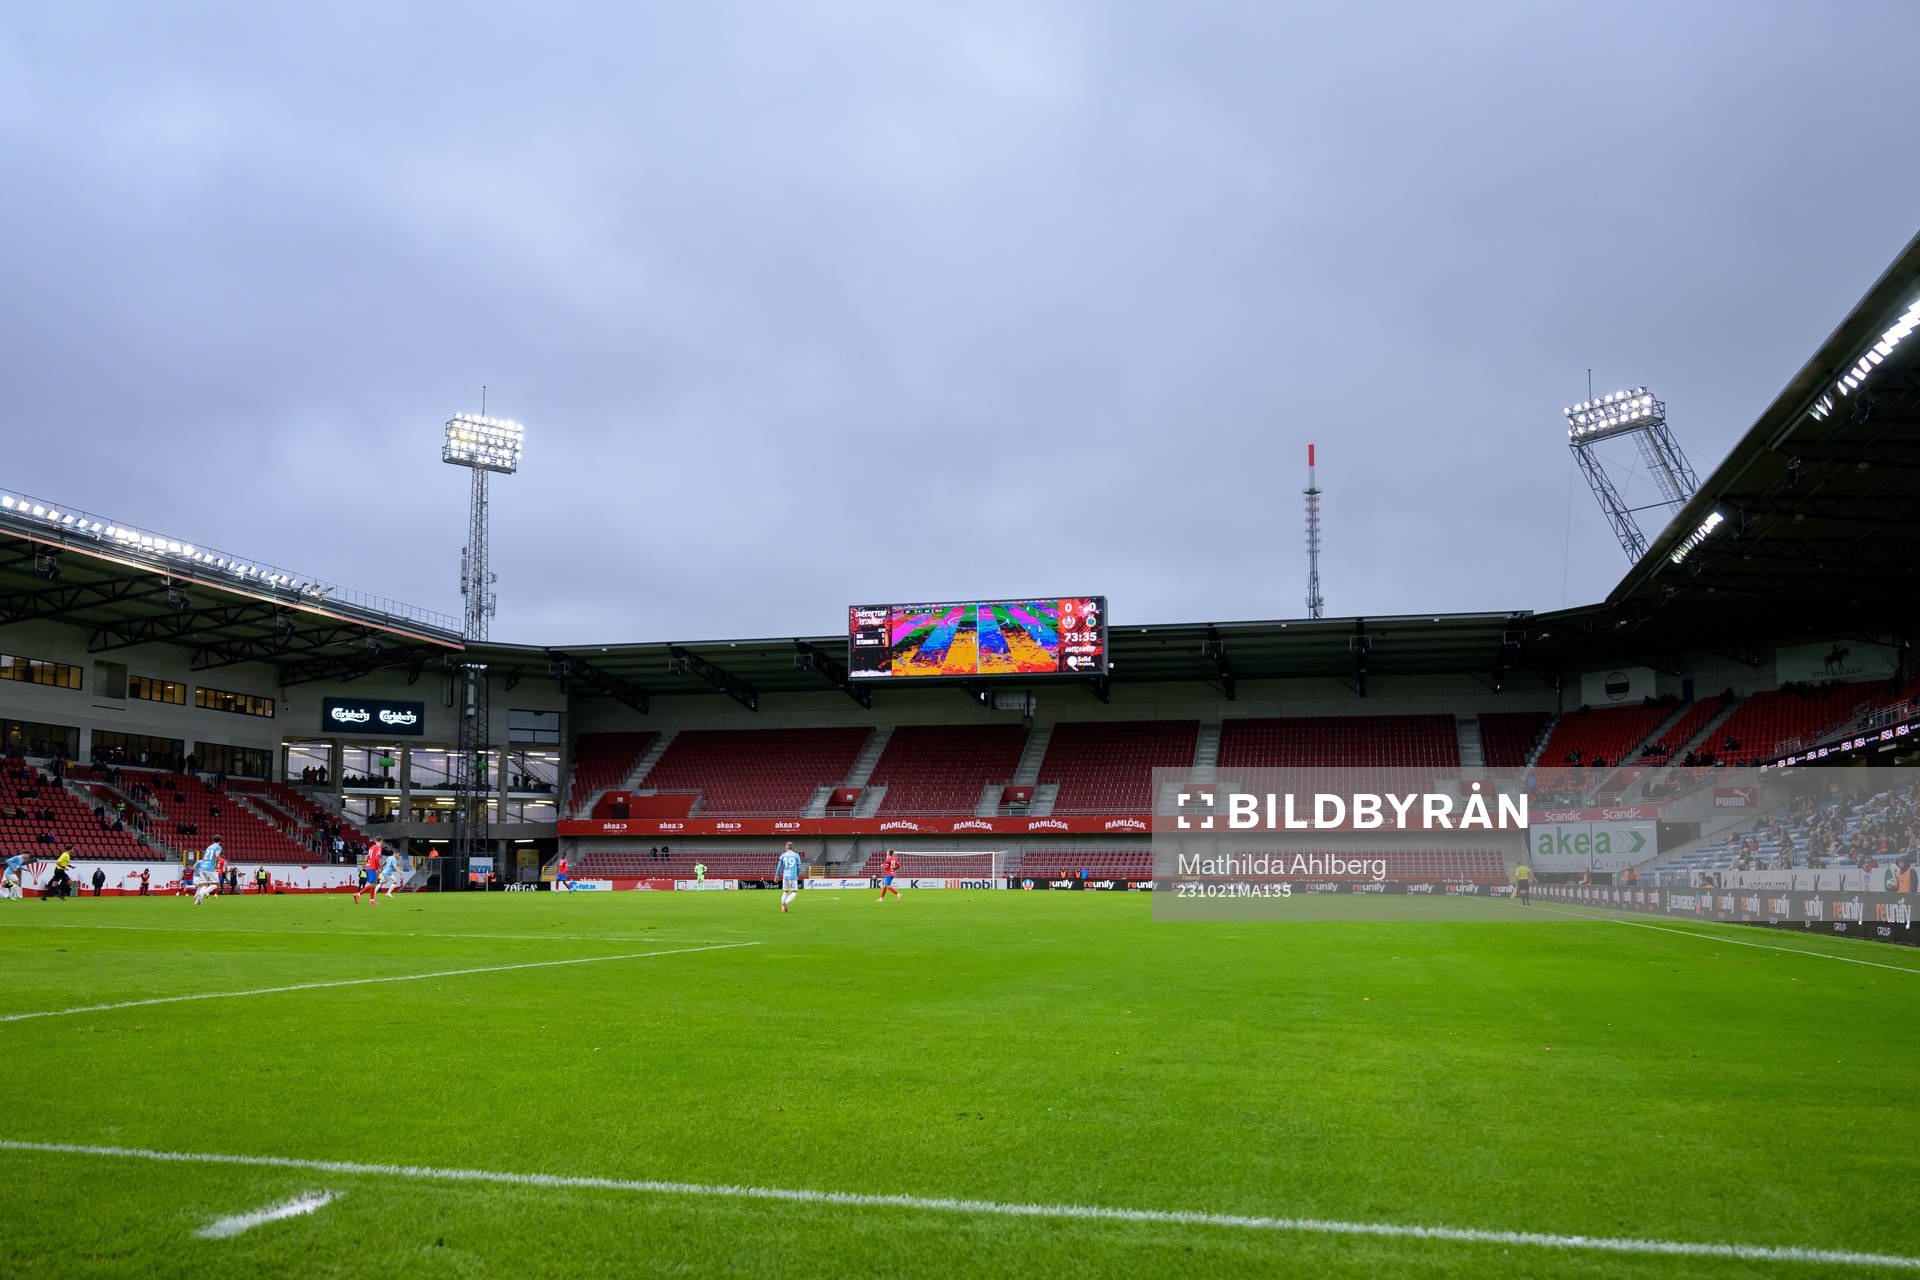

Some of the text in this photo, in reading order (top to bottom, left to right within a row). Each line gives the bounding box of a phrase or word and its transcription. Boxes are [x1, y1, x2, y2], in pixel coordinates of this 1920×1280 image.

[1065, 603, 1072, 613] 0
[1089, 602, 1097, 612] 0
[1064, 632, 1097, 643] 73:35
[331, 707, 370, 723] Carlsberg
[379, 710, 417, 725] Carlsberg
[1545, 811, 1581, 821] Scandic
[1603, 808, 1642, 819] Scandic
[603, 822, 620, 830] akea
[775, 821, 791, 829] akea
[880, 820, 918, 831] RAMLÖSA
[953, 820, 993, 831] RAMLÖSA
[1028, 819, 1069, 830] RAMLÖSA
[1105, 818, 1146, 830] RAMLÖSA
[1538, 826, 1611, 855] akea
[783, 857, 796, 868] 19
[1084, 880, 1114, 889] reunify
[1128, 880, 1157, 890] reunify
[1306, 882, 1338, 892] reunify
[1353, 883, 1385, 893] reunify
[1445, 884, 1479, 894] reunify
[1833, 896, 1864, 926] reunify
[1875, 898, 1911, 930] reunify
